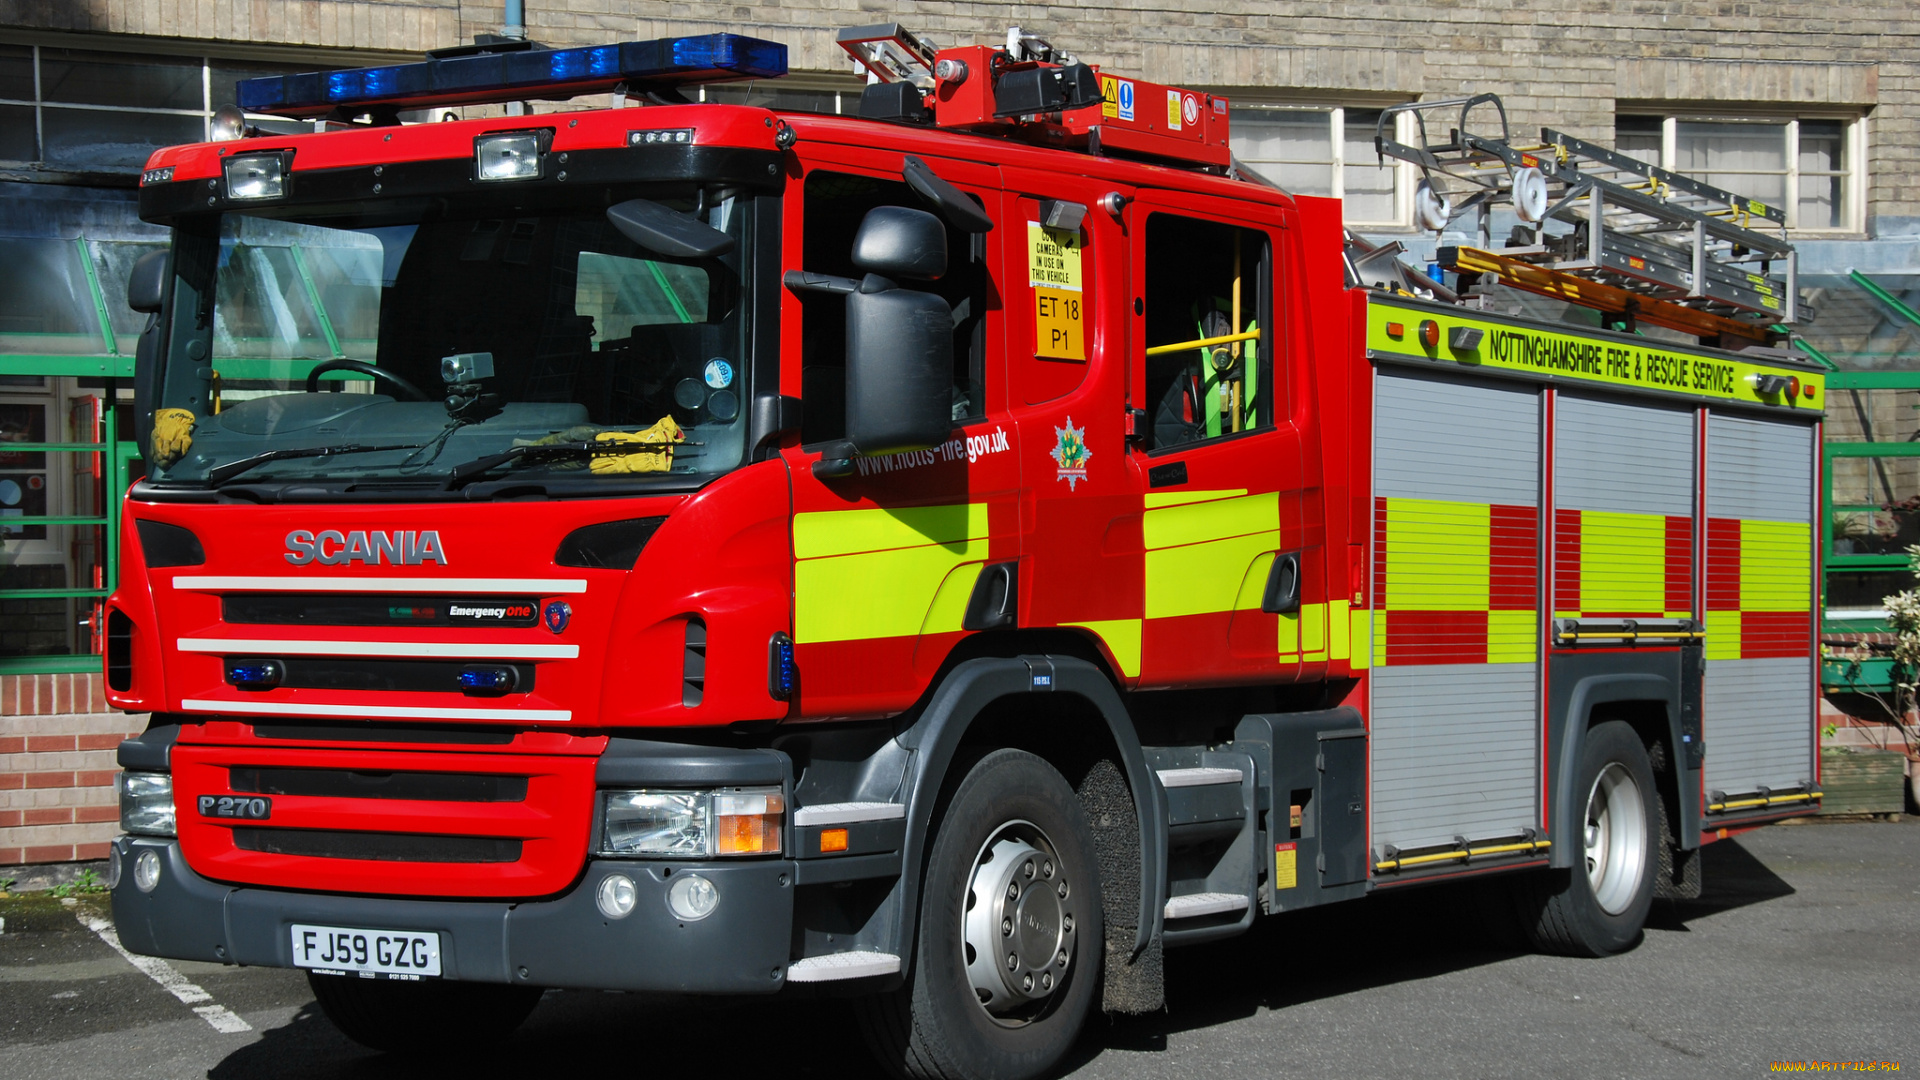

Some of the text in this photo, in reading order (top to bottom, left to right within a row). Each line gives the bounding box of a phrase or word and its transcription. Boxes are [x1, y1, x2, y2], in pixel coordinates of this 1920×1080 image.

[1036, 242, 1063, 257] CAMERAS
[1036, 256, 1064, 270] IN USE ON
[1032, 268, 1069, 283] THIS VEHICLE
[1039, 295, 1079, 320] ET 18
[1051, 328, 1068, 350] P1
[1490, 329, 1735, 394] NOTTINGHAMSHIRE FIRE & RESCUE SERVICE
[284, 529, 448, 567] SCANIA
[199, 796, 266, 818] P 270
[303, 931, 428, 969] FJ59 GZG
